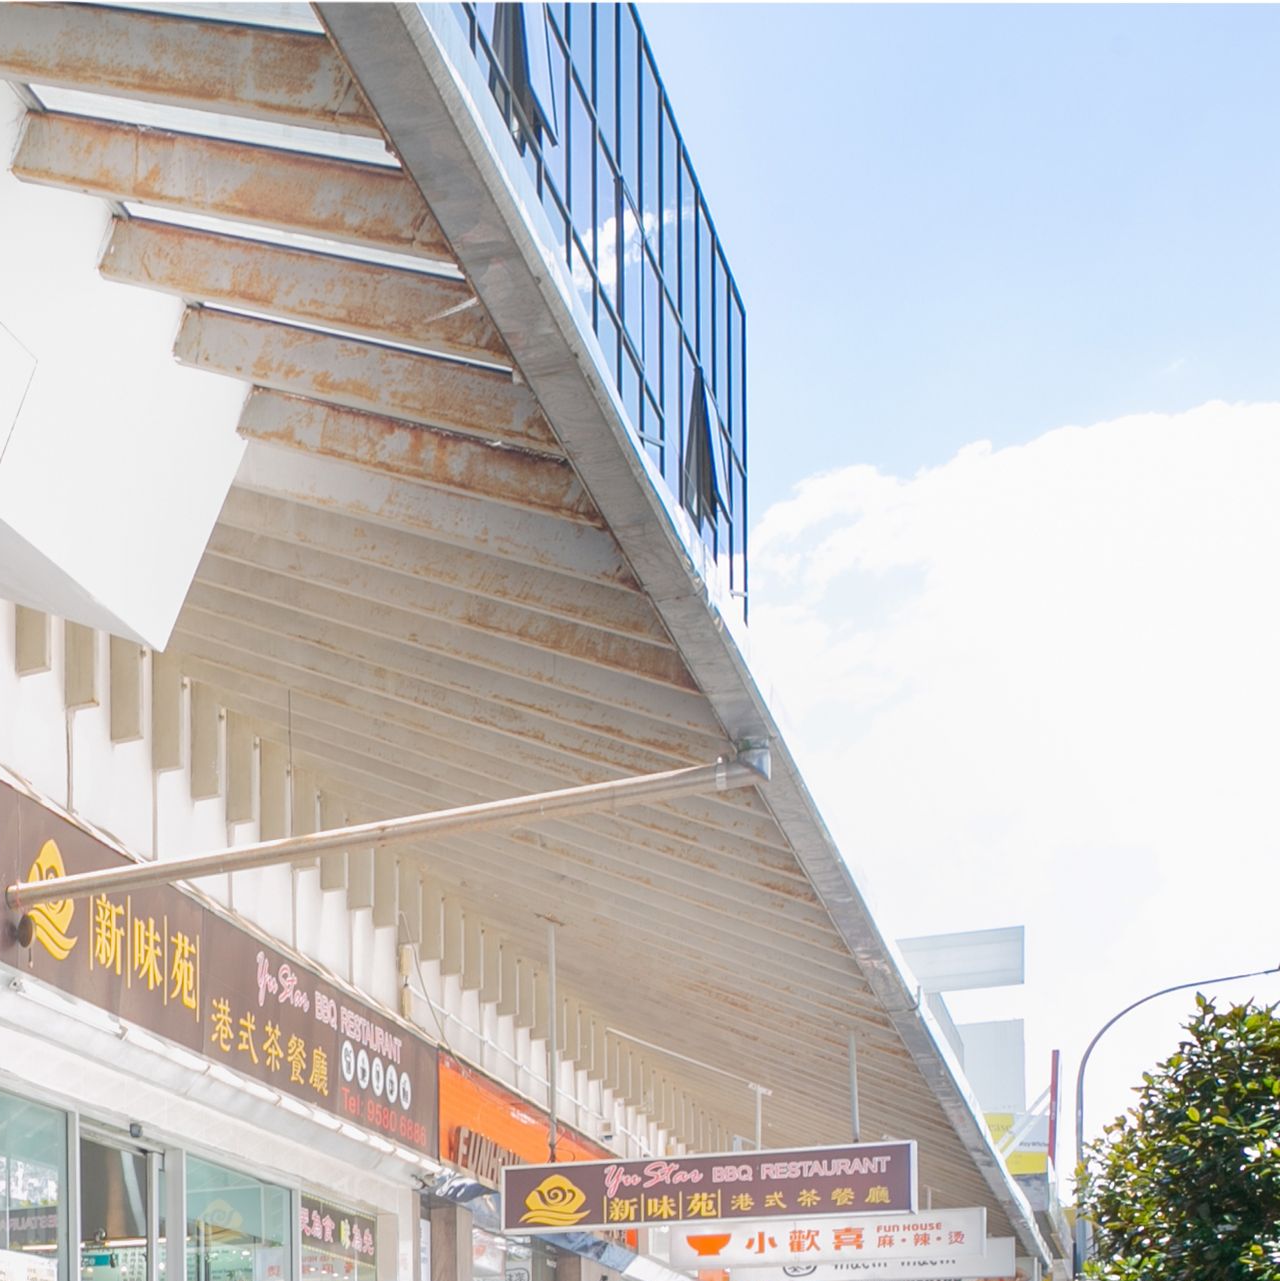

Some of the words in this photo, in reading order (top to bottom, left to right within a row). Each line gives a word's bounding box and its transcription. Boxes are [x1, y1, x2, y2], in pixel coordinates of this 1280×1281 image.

[95, 894, 197, 1010] 新味苑
[314, 991, 338, 1030] BBQ
[340, 1006, 402, 1064] RESTAURANT
[211, 997, 329, 1096] 港式茶餐廳
[643, 1161, 704, 1188] Star
[712, 1165, 753, 1183] BBQ
[760, 1156, 891, 1180] RESTAURANT
[608, 1192, 718, 1221] 新味苑
[731, 1185, 891, 1211] 港式茶餐廳
[745, 1226, 865, 1254] 小歡喜
[876, 1224, 900, 1233] FUN
[903, 1222, 943, 1232] HOUSE
